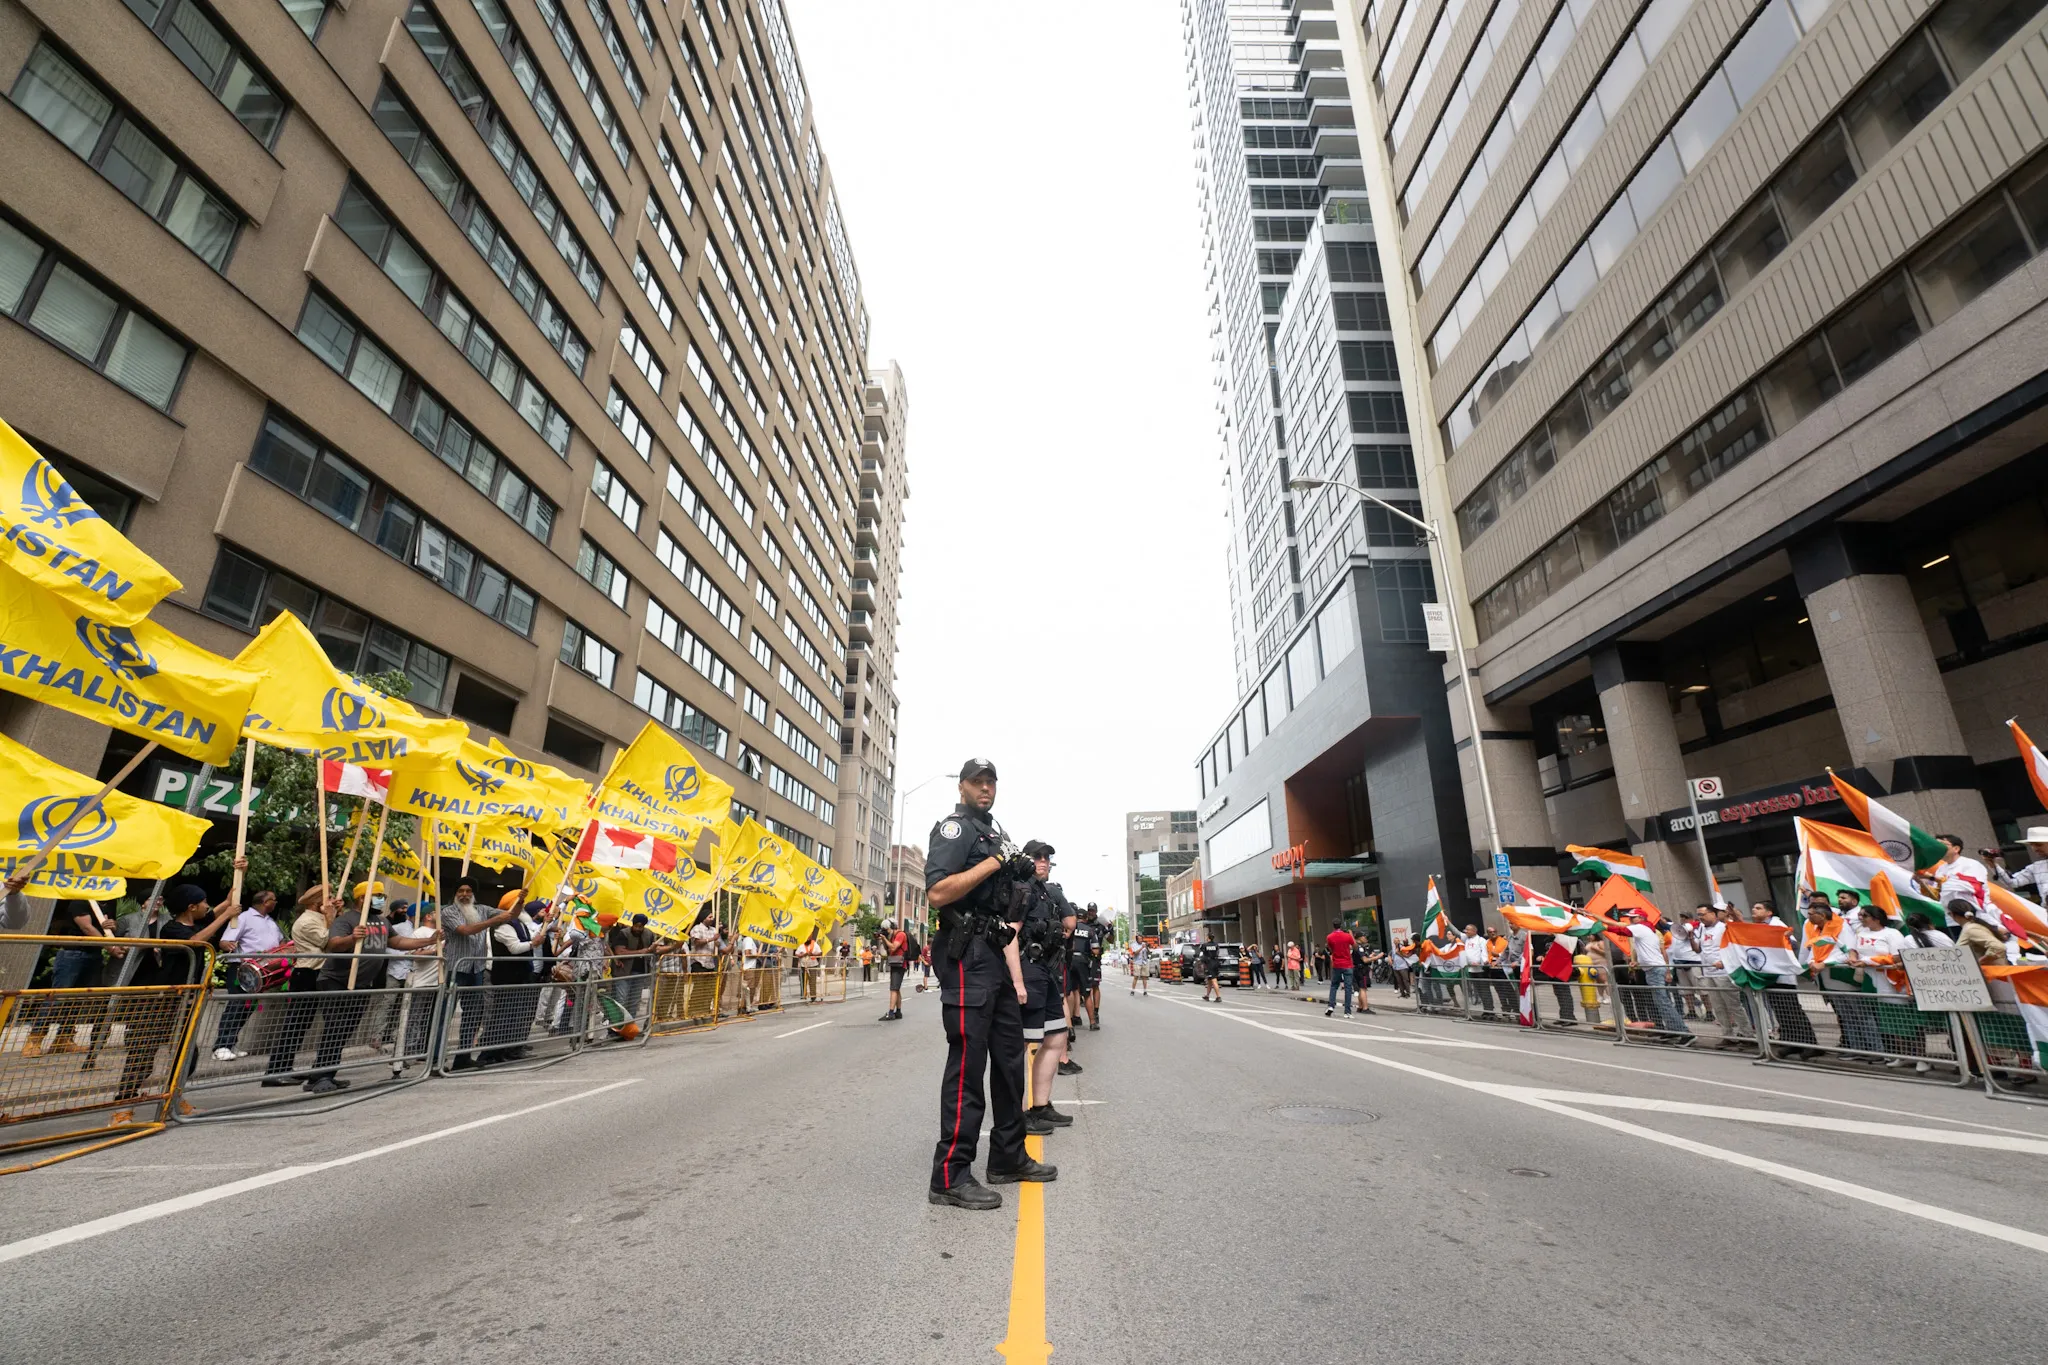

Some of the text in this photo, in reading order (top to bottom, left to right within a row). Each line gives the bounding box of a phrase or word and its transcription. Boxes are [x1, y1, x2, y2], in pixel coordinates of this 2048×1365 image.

[0, 644, 217, 744] KHALISTAN
[409, 788, 544, 822] KHALISTAN
[1719, 792, 1800, 823] espresso
[598, 801, 690, 841] KHALISTAN
[1271, 840, 1309, 879] canopy
[652, 870, 704, 901] KHALISTAN
[748, 924, 799, 944] KHALISTAN
[1074, 929, 1088, 937] LICE
[1940, 949, 1962, 962] STOP
[1917, 989, 1983, 1005] TERRORISTS
